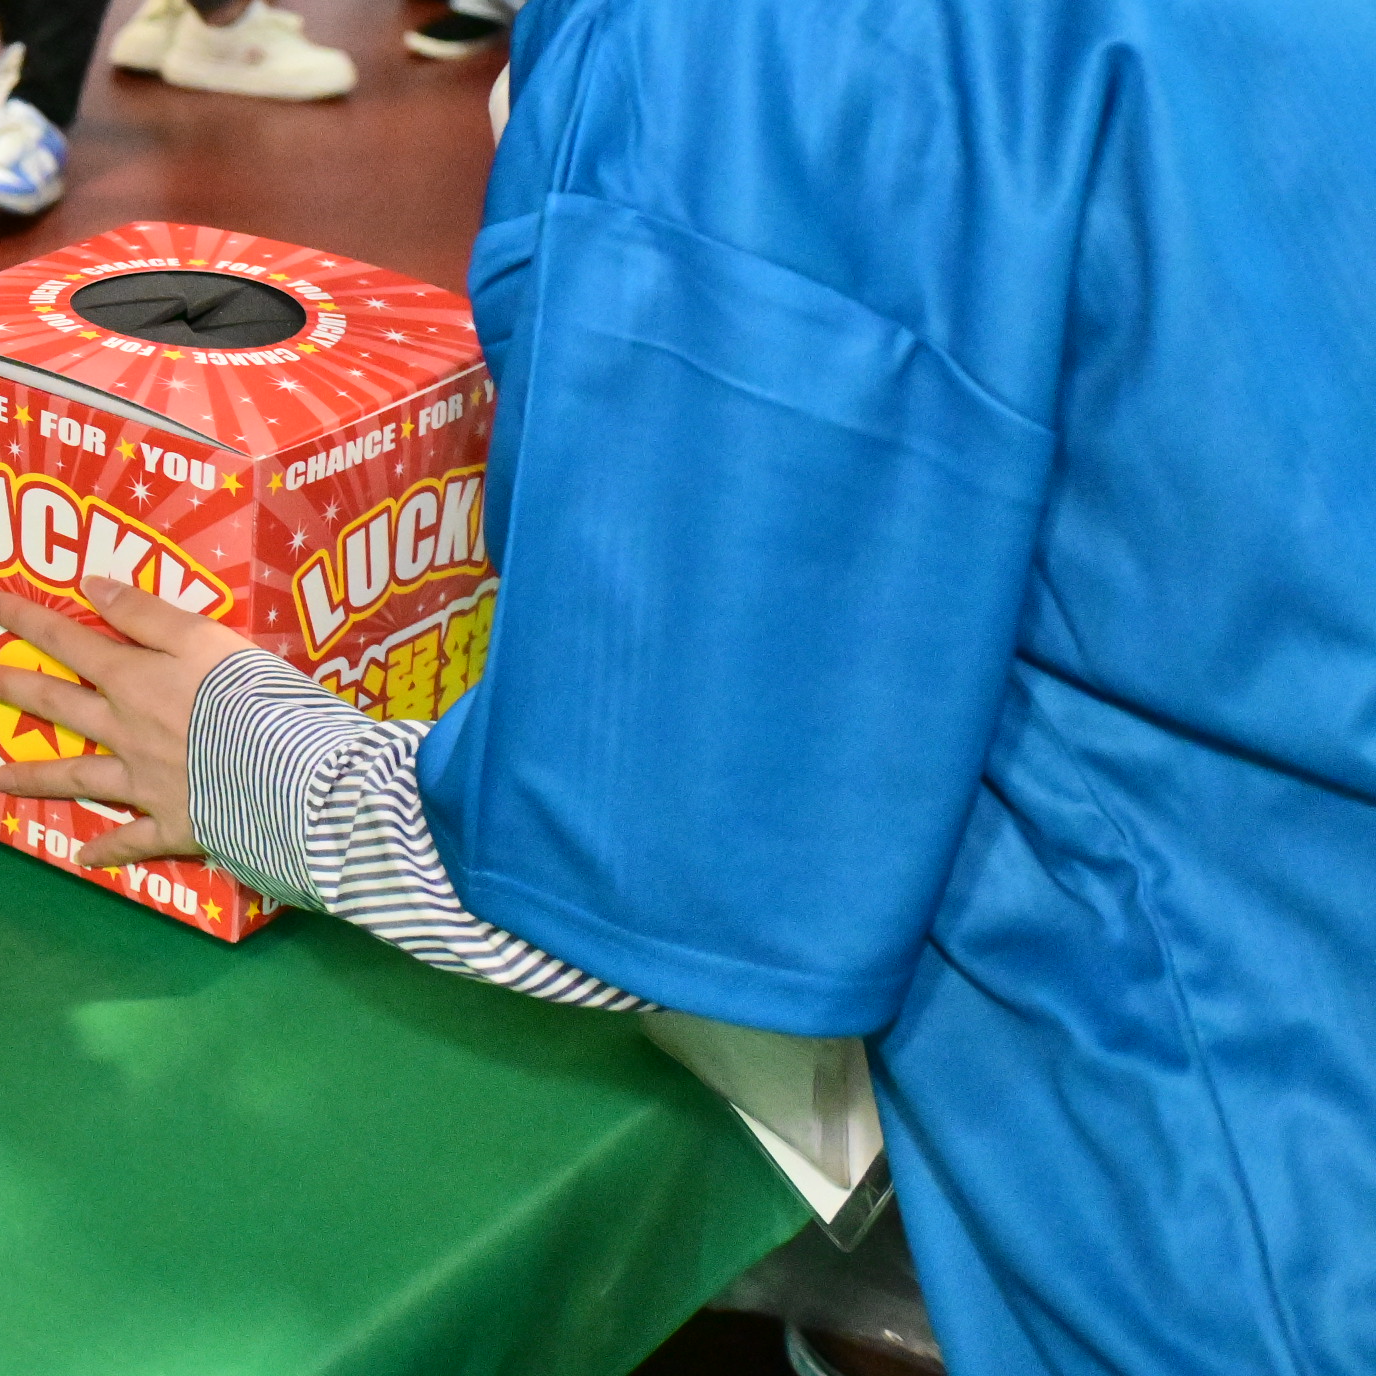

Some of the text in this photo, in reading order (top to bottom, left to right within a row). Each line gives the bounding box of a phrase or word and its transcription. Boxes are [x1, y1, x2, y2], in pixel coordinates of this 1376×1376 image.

[28, 258, 334, 304] LUCKY CHANCE FOR YOU
[38, 311, 347, 366] LUCKY CHANCE FOR YOU
[40, 409, 106, 457] FOR
[140, 441, 216, 491] YOU
[285, 422, 396, 492] CHANCE
[418, 392, 463, 437] FOR
[300, 477, 486, 647] LUCK
[126, 863, 199, 916] YOU
